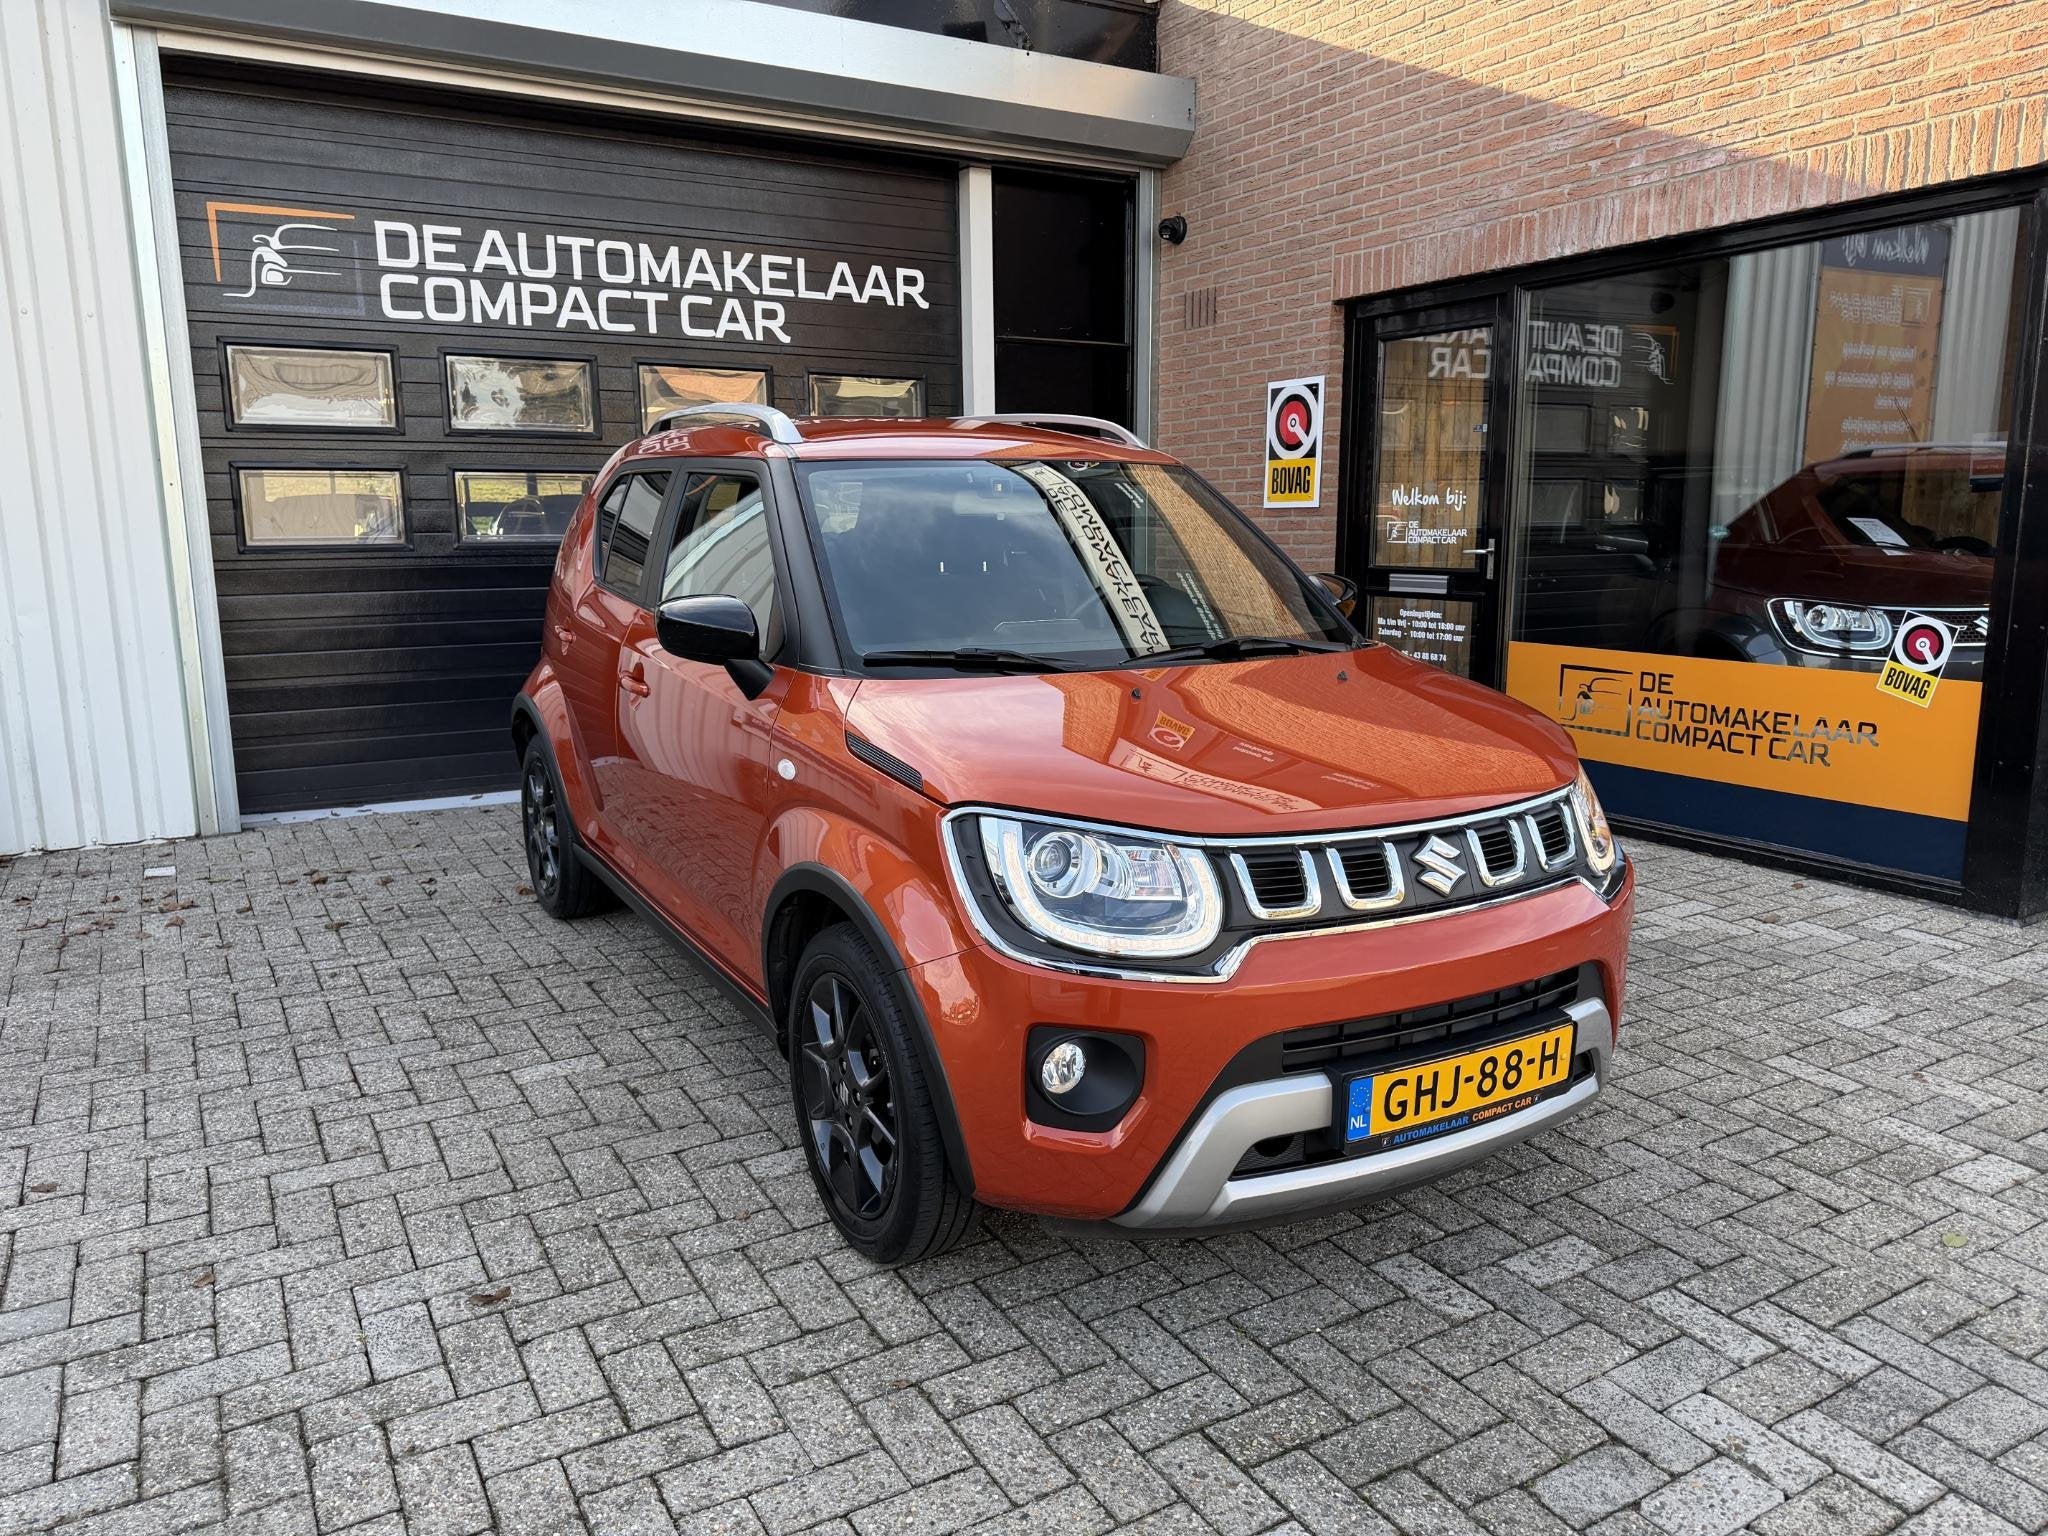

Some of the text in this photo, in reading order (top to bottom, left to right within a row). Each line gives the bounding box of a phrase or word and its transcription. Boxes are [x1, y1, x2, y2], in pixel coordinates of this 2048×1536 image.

[374, 220, 930, 310] DE AUTOMAKELAAR
[380, 273, 791, 344] COMPACT CAR
[1271, 465, 1311, 495] BOVAG
[1392, 484, 1467, 511] Welkom bij:
[1408, 529, 1467, 537] AUTOMAKELAAR
[1408, 536, 1441, 544] COMPACT
[1378, 628, 1402, 638] Zaterdag
[1410, 630, 1426, 639] 10:00
[1426, 631, 1435, 639] tot
[1436, 632, 1453, 641] 17:00
[1396, 619, 1407, 627] Vrij
[1411, 620, 1428, 628] 10:00
[1428, 621, 1437, 629] tot
[1454, 624, 1466, 632] uur
[1413, 651, 1421, 659] 43
[1439, 653, 1447, 661] 74
[1640, 671, 1674, 695] DE
[1884, 667, 1931, 700] BOVAG
[1637, 696, 1880, 748] AUTOMAKELAAR
[1636, 719, 1832, 768] COMPACT CAR
[1383, 1036, 1561, 1123] GHJ-88-H
[1350, 1116, 1367, 1130] NL
[1393, 1096, 1532, 1145] AUTOMAKELAAR COMPACT CAR
